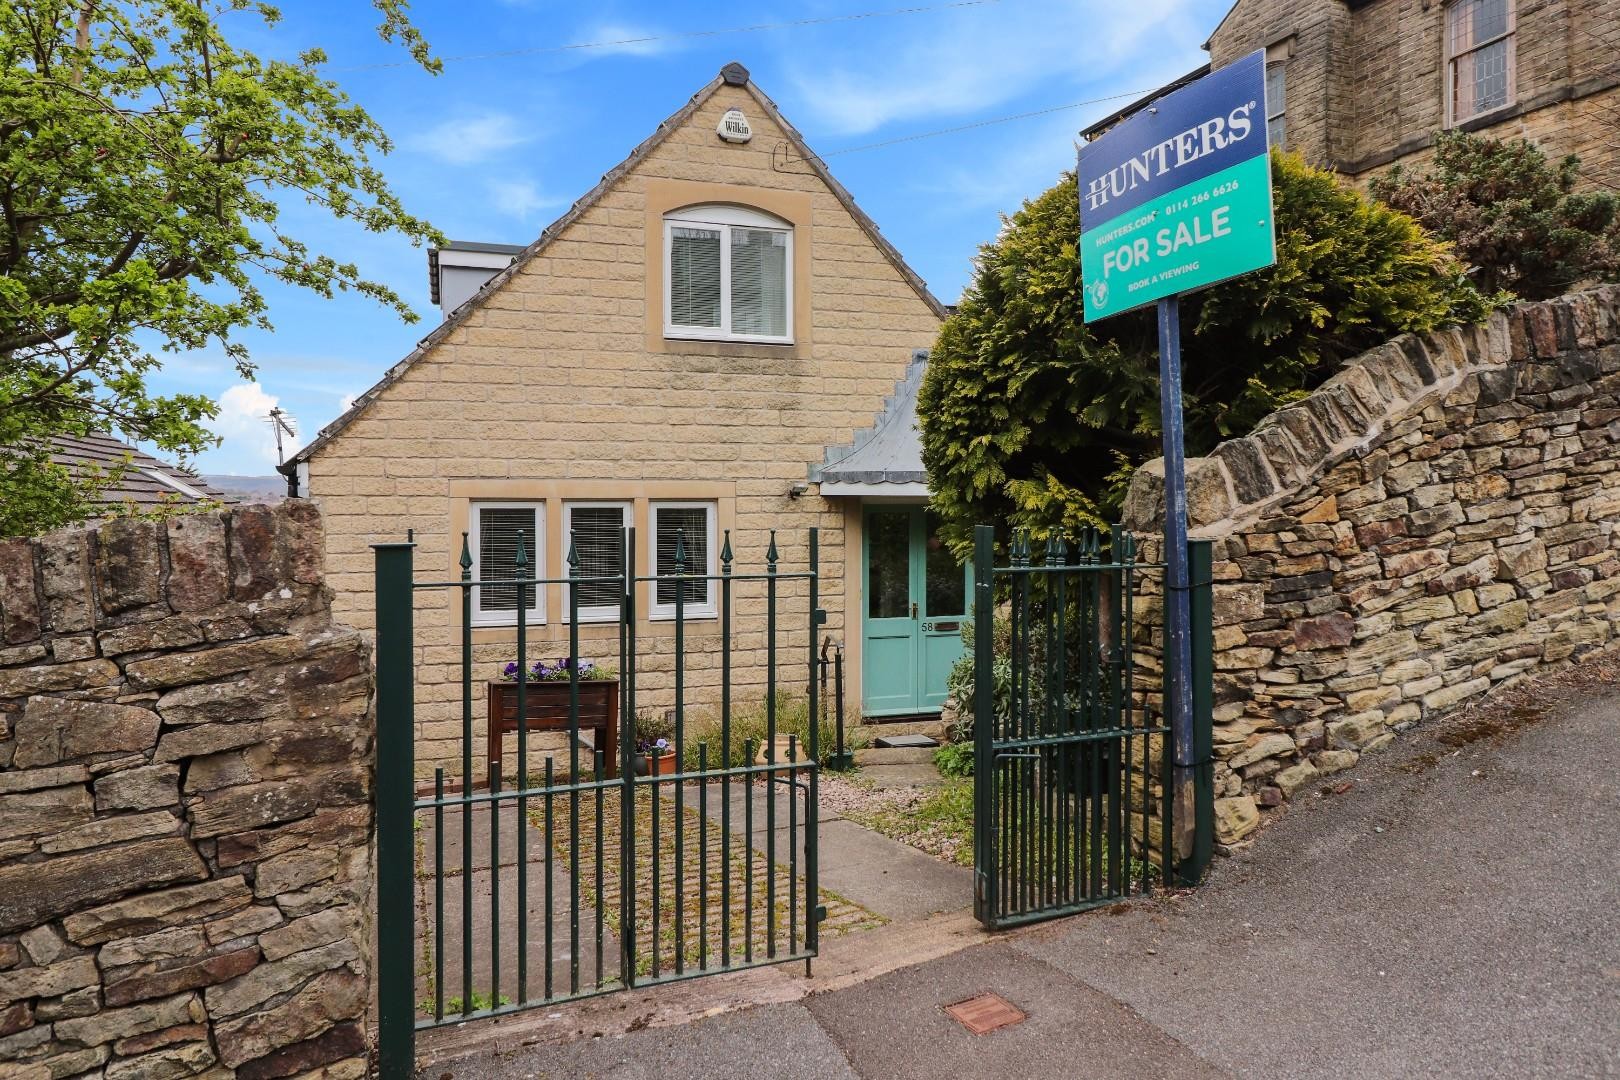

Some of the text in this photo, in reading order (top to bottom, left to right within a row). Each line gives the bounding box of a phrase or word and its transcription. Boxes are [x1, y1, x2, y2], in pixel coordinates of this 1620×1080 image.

[725, 120, 749, 135] Wilkin
[1165, 199, 1189, 215] 0114
[1192, 191, 1210, 206] 266
[1213, 180, 1239, 197] 6626
[1103, 205, 1232, 279] FOR SALE
[1128, 261, 1200, 292] BOOK A VIEWING
[921, 622, 933, 632] 58
